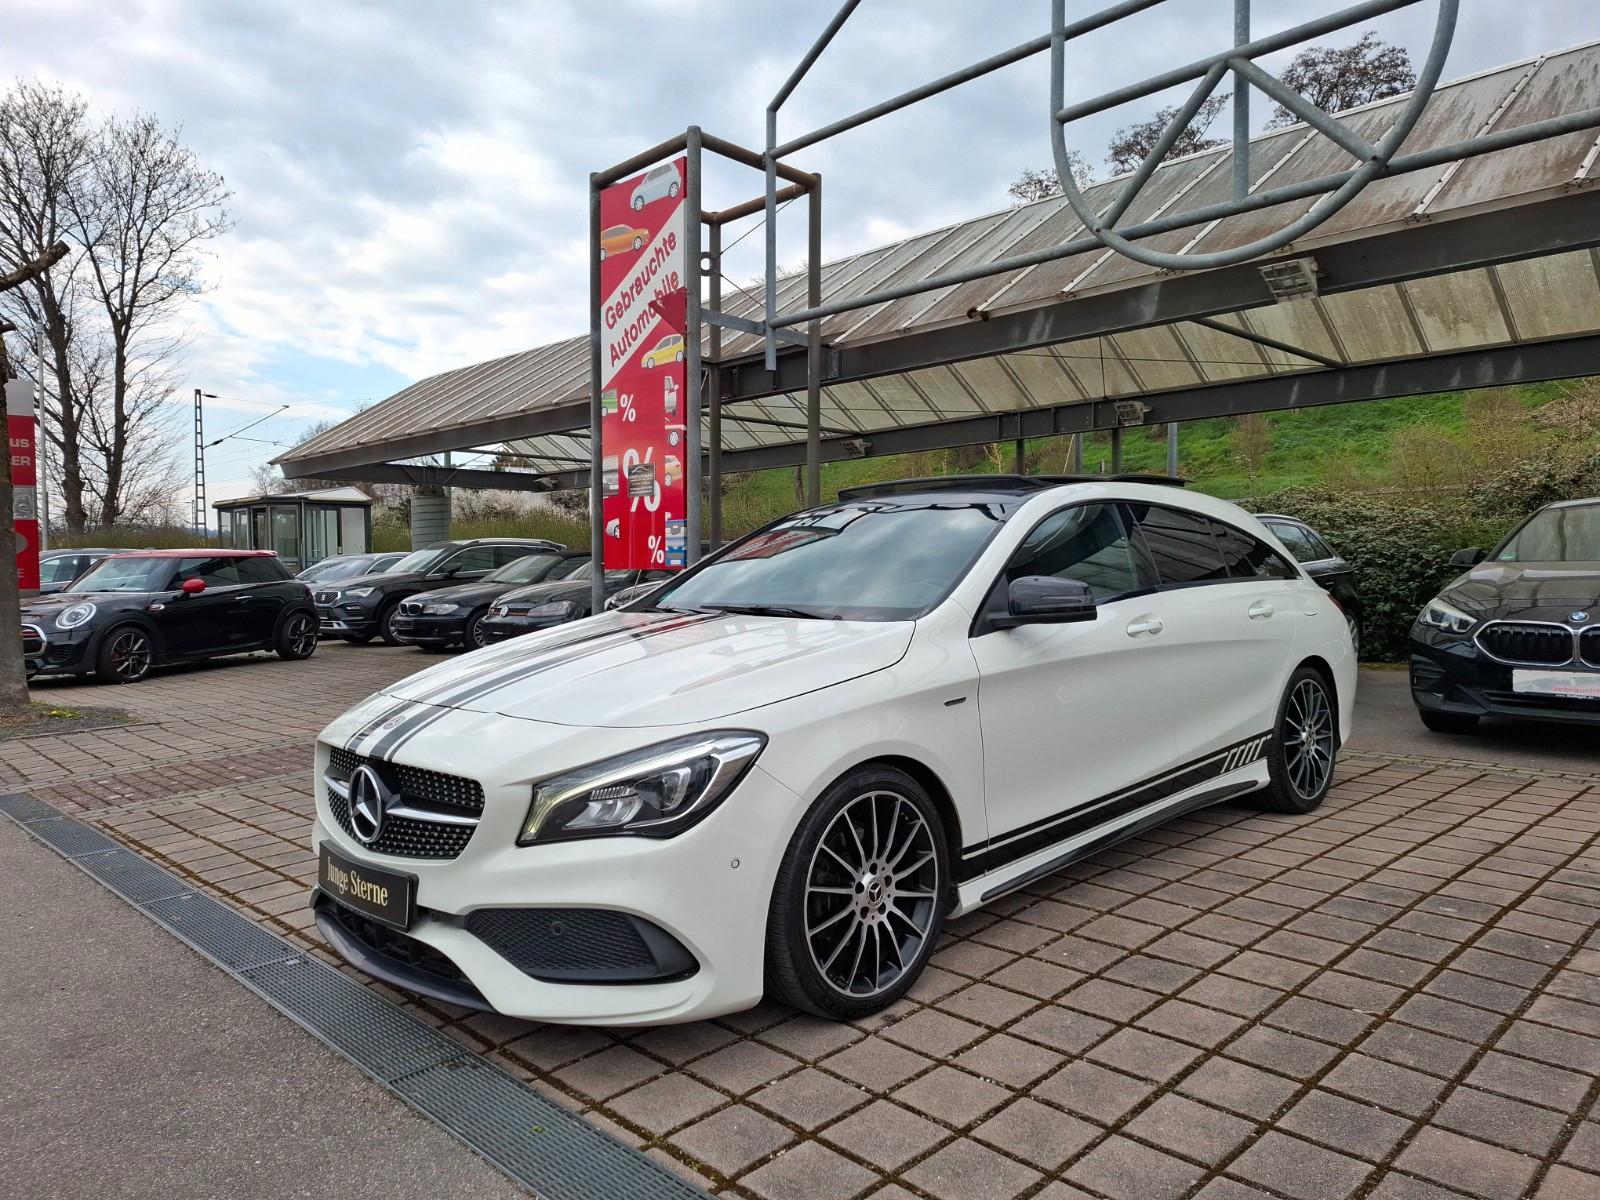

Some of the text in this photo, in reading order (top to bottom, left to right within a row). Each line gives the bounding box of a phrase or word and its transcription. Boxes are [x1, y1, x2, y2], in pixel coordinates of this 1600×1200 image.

[605, 231, 677, 330] Gebrauchte
[620, 394, 636, 422] %
[11, 455, 31, 466] ER
[623, 446, 661, 513] %
[647, 535, 664, 564] %
[327, 856, 388, 906] Junge Sterne
